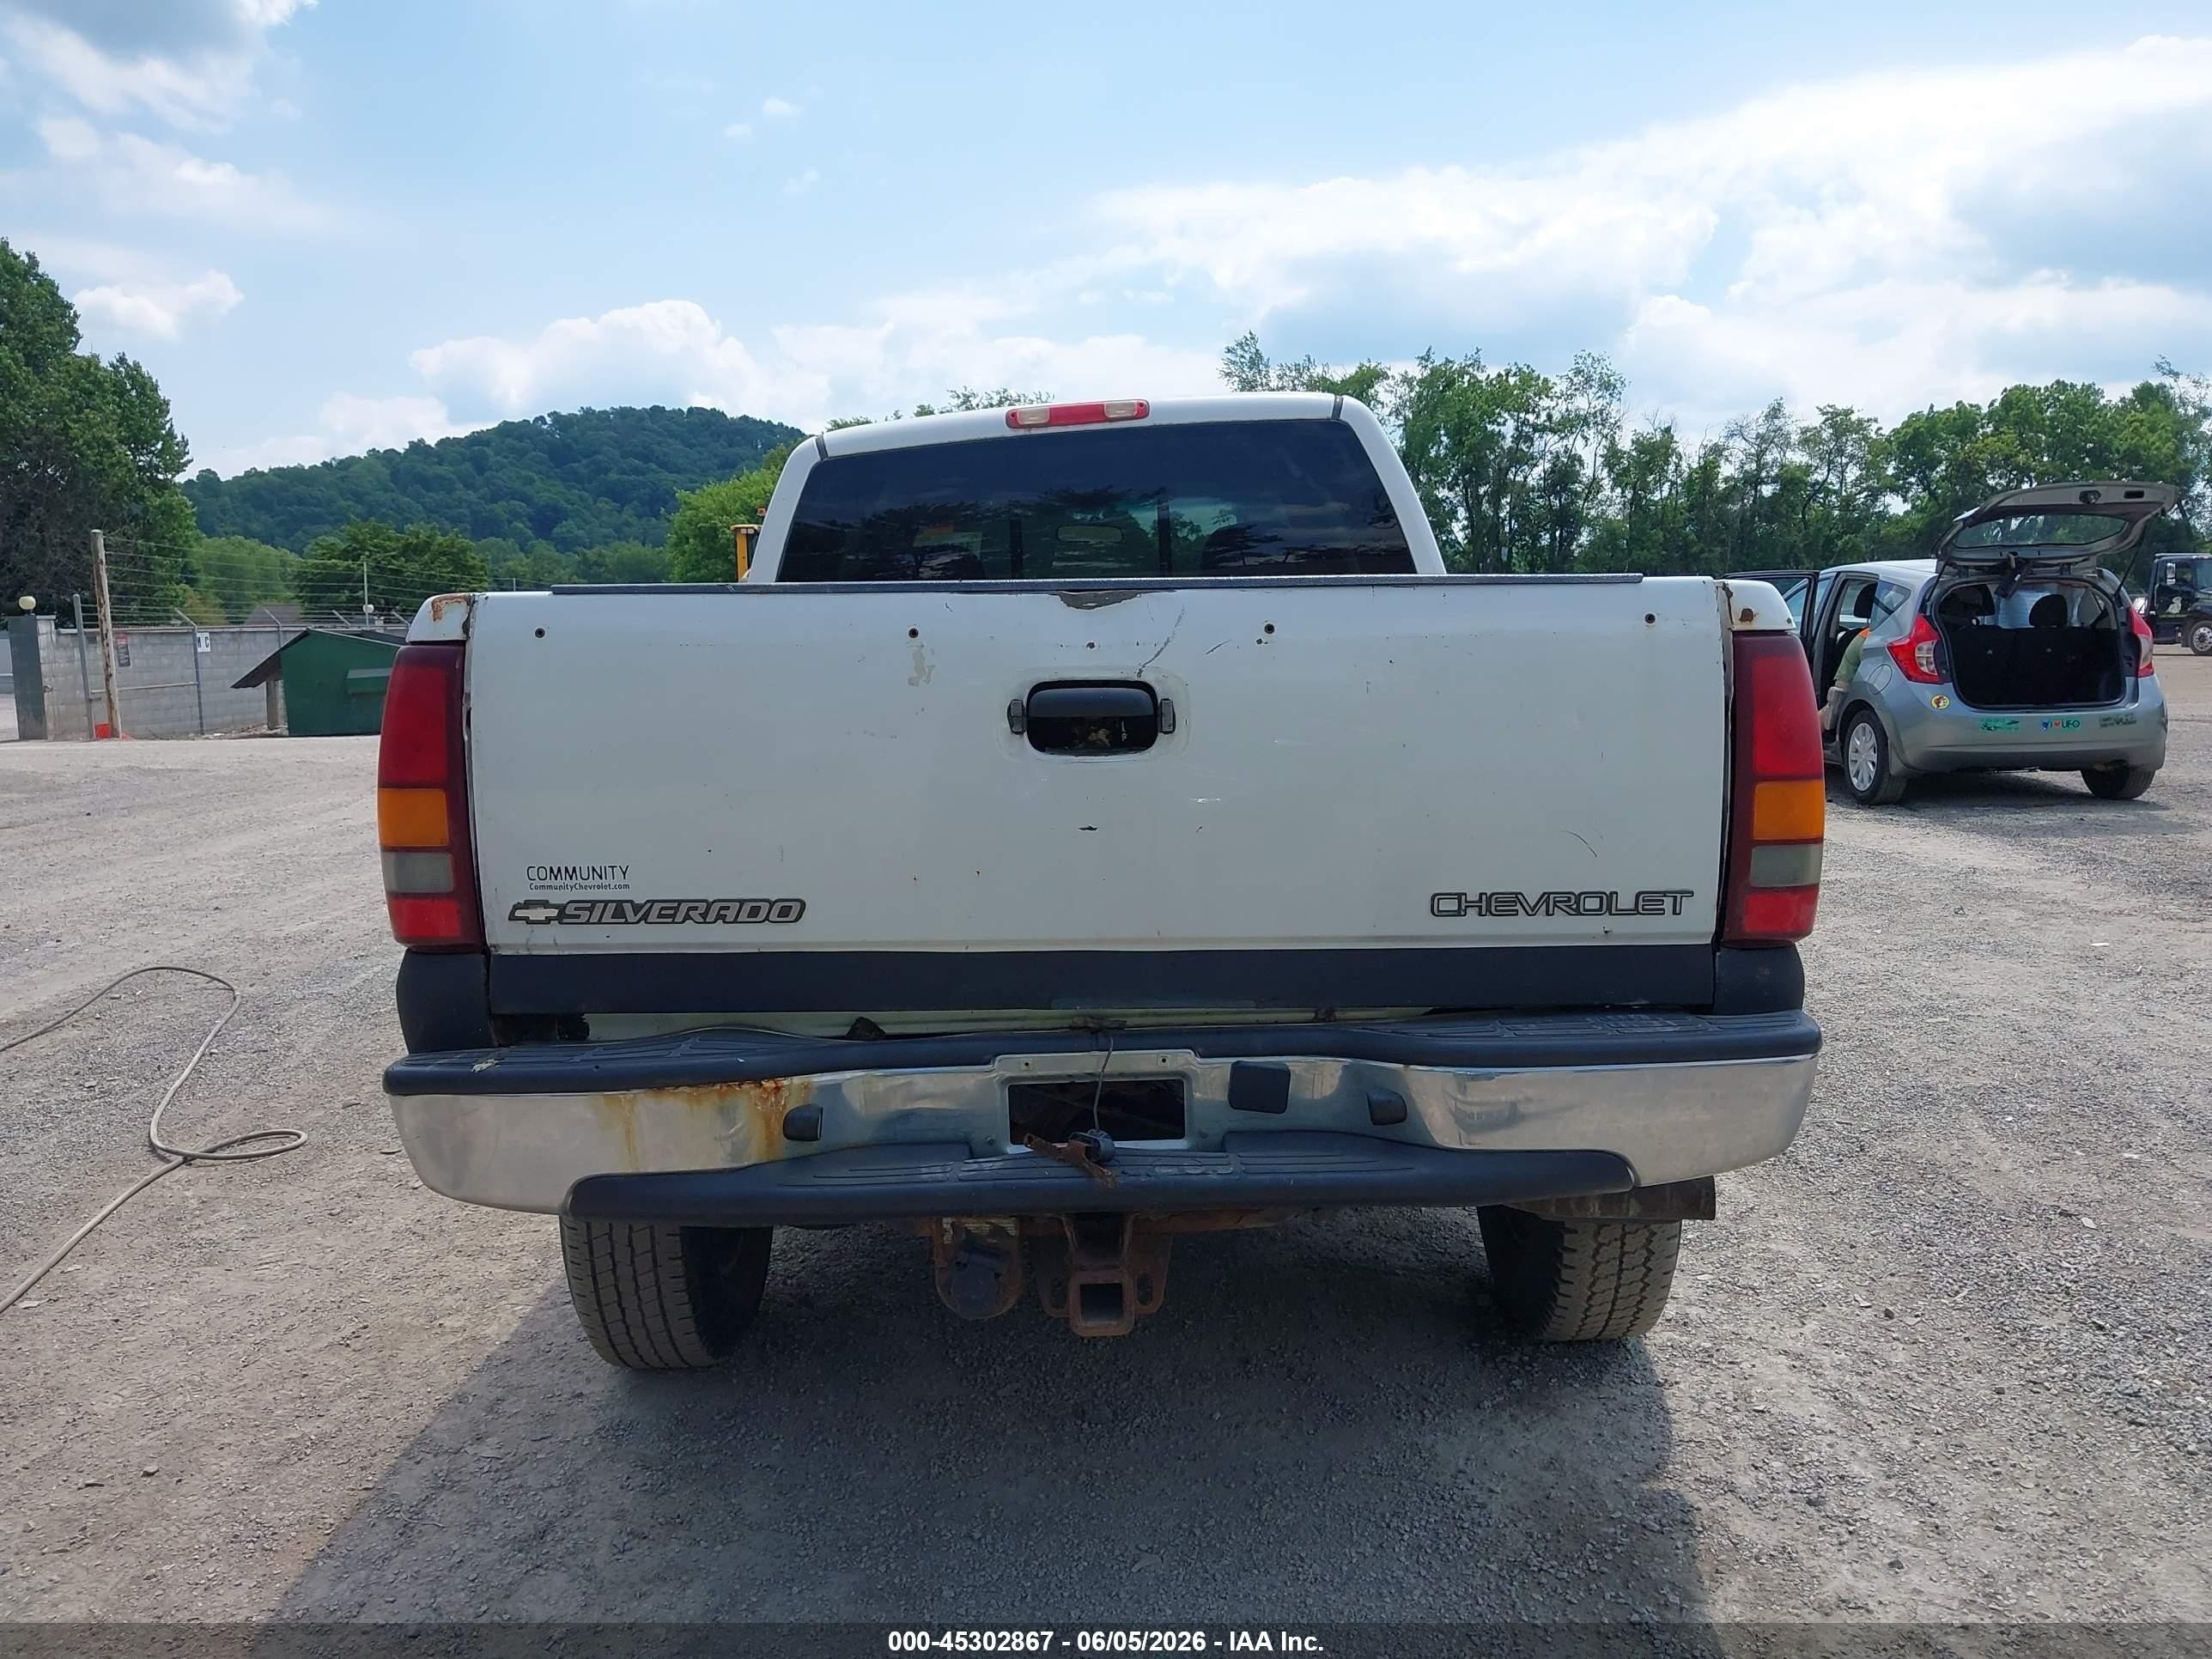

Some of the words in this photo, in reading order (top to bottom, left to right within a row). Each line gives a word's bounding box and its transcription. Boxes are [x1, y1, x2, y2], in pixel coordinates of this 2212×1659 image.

[2061, 720, 2081, 728] UFO
[526, 865, 629, 881] COMMUNITY
[529, 882, 630, 892] CommunityChevrolet.com
[559, 898, 806, 925] SILVERADO
[1430, 890, 1695, 917] CHEVROLET
